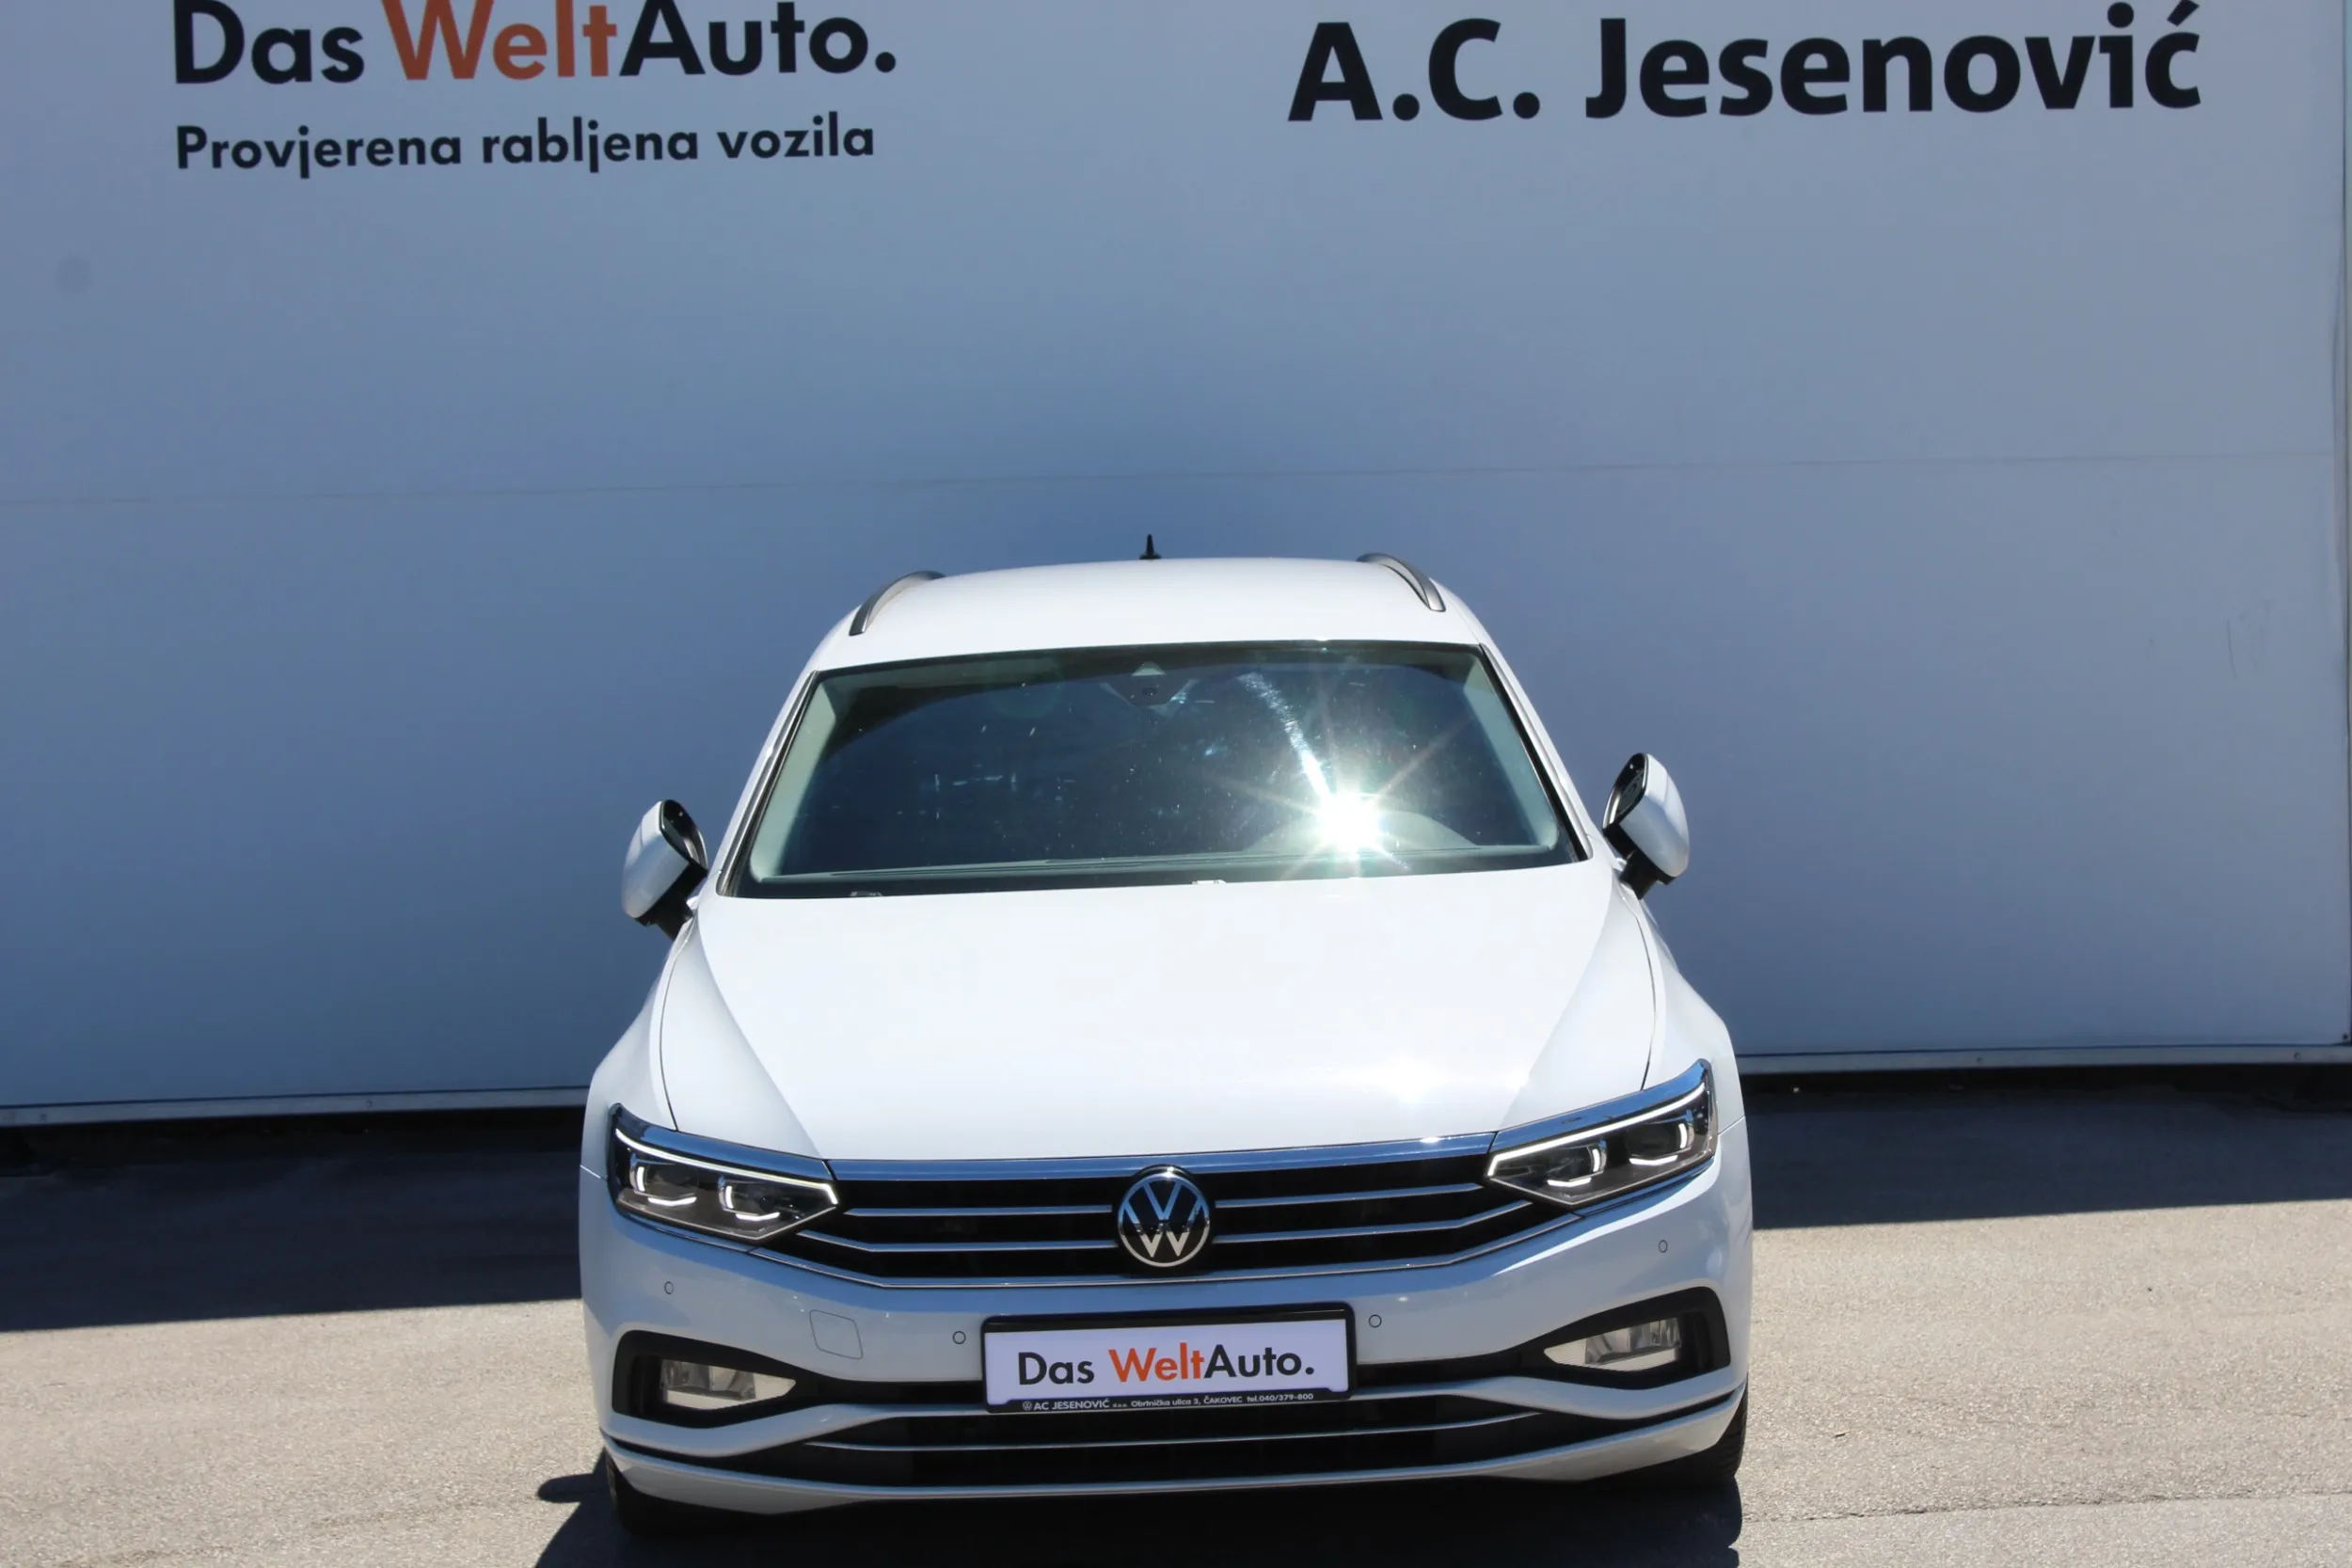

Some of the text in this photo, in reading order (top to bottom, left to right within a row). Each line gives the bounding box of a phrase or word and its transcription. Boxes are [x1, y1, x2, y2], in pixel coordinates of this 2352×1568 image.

[174, 0, 897, 85] Das WeltAuto.
[1288, 0, 2201, 121] A.C. Jesenović
[176, 111, 875, 179] Provjerena rabljena vozila
[1018, 1342, 1314, 1386] Das WeltAuto.
[1033, 1402, 1049, 1411] AC
[1052, 1398, 1110, 1410] JESENOVIĆ
[1131, 1399, 1170, 1407] Obrtnička
[1172, 1398, 1191, 1406] ulica
[1203, 1395, 1243, 1404] ČAKOVEC
